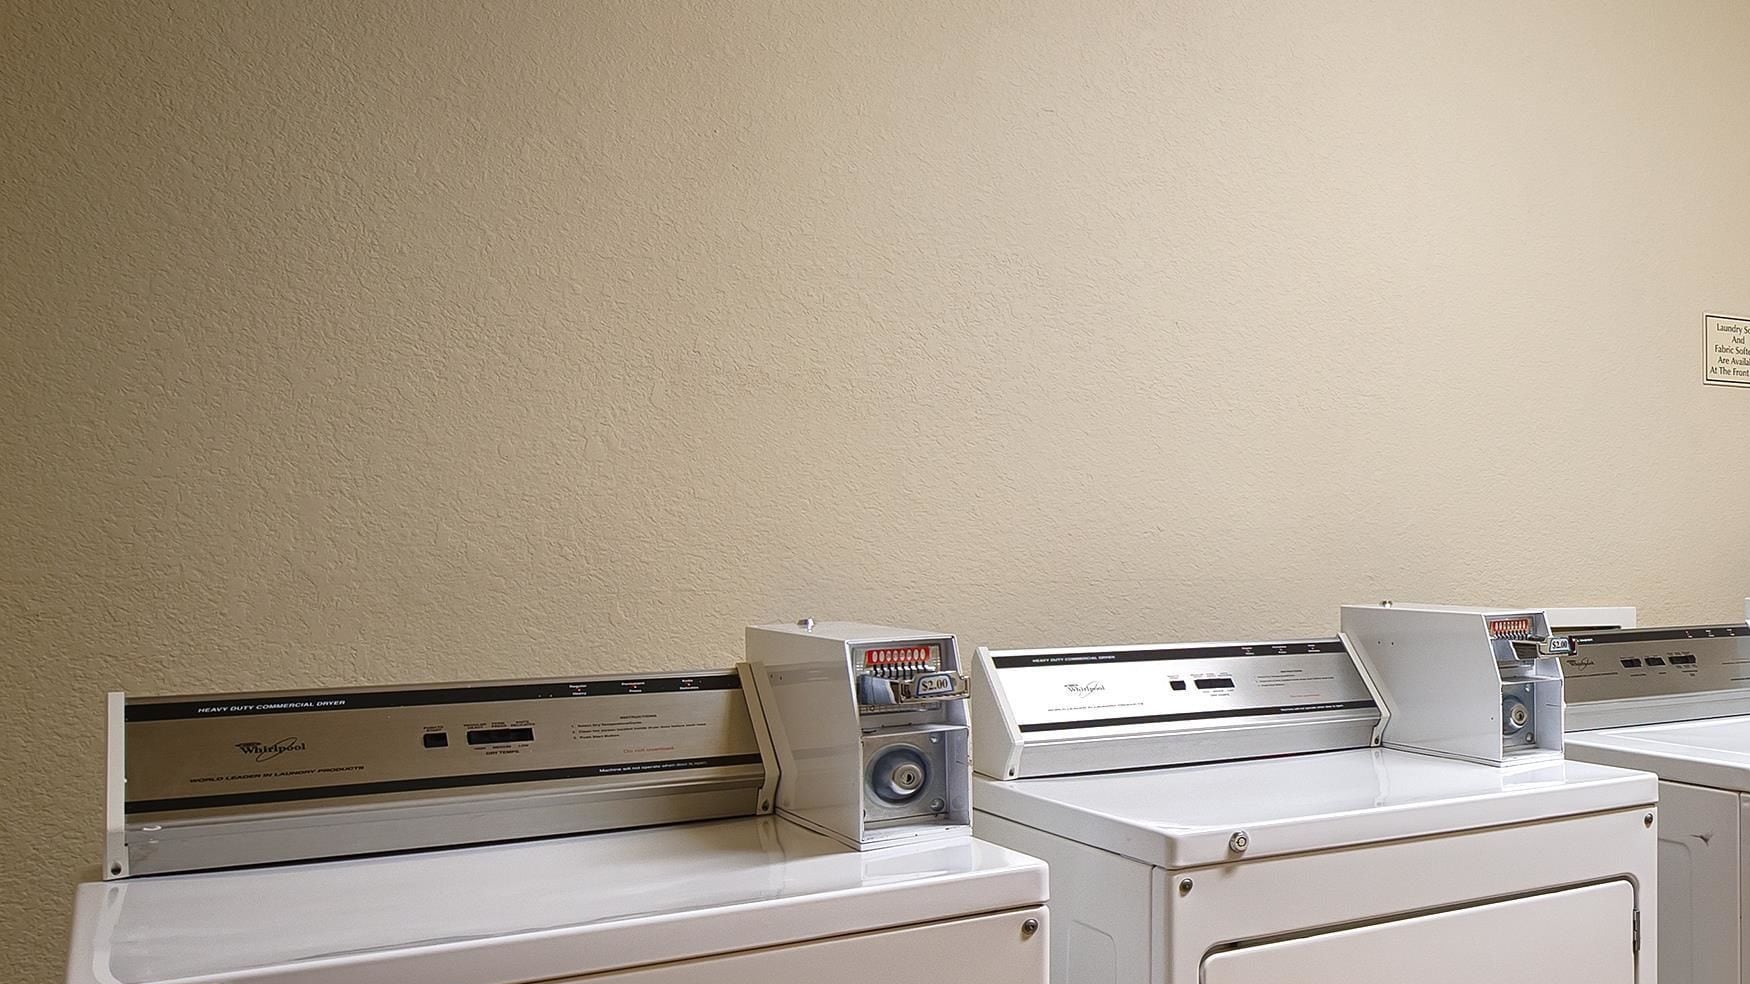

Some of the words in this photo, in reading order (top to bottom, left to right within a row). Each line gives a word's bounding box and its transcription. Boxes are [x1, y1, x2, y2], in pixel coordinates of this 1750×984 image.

[1717, 323, 1742, 335] Laundry
[1732, 336, 1745, 344] And
[1715, 345, 1734, 354] Fabric
[1718, 356, 1729, 364] Are
[1710, 366, 1717, 374] At
[1719, 367, 1731, 375] The
[1733, 368, 1749, 376] Front
[1552, 641, 1567, 649] $2.00
[922, 679, 948, 691] $2.00
[256, 702, 315, 710] COMMERCIAL
[240, 743, 305, 754] Whirlpool
